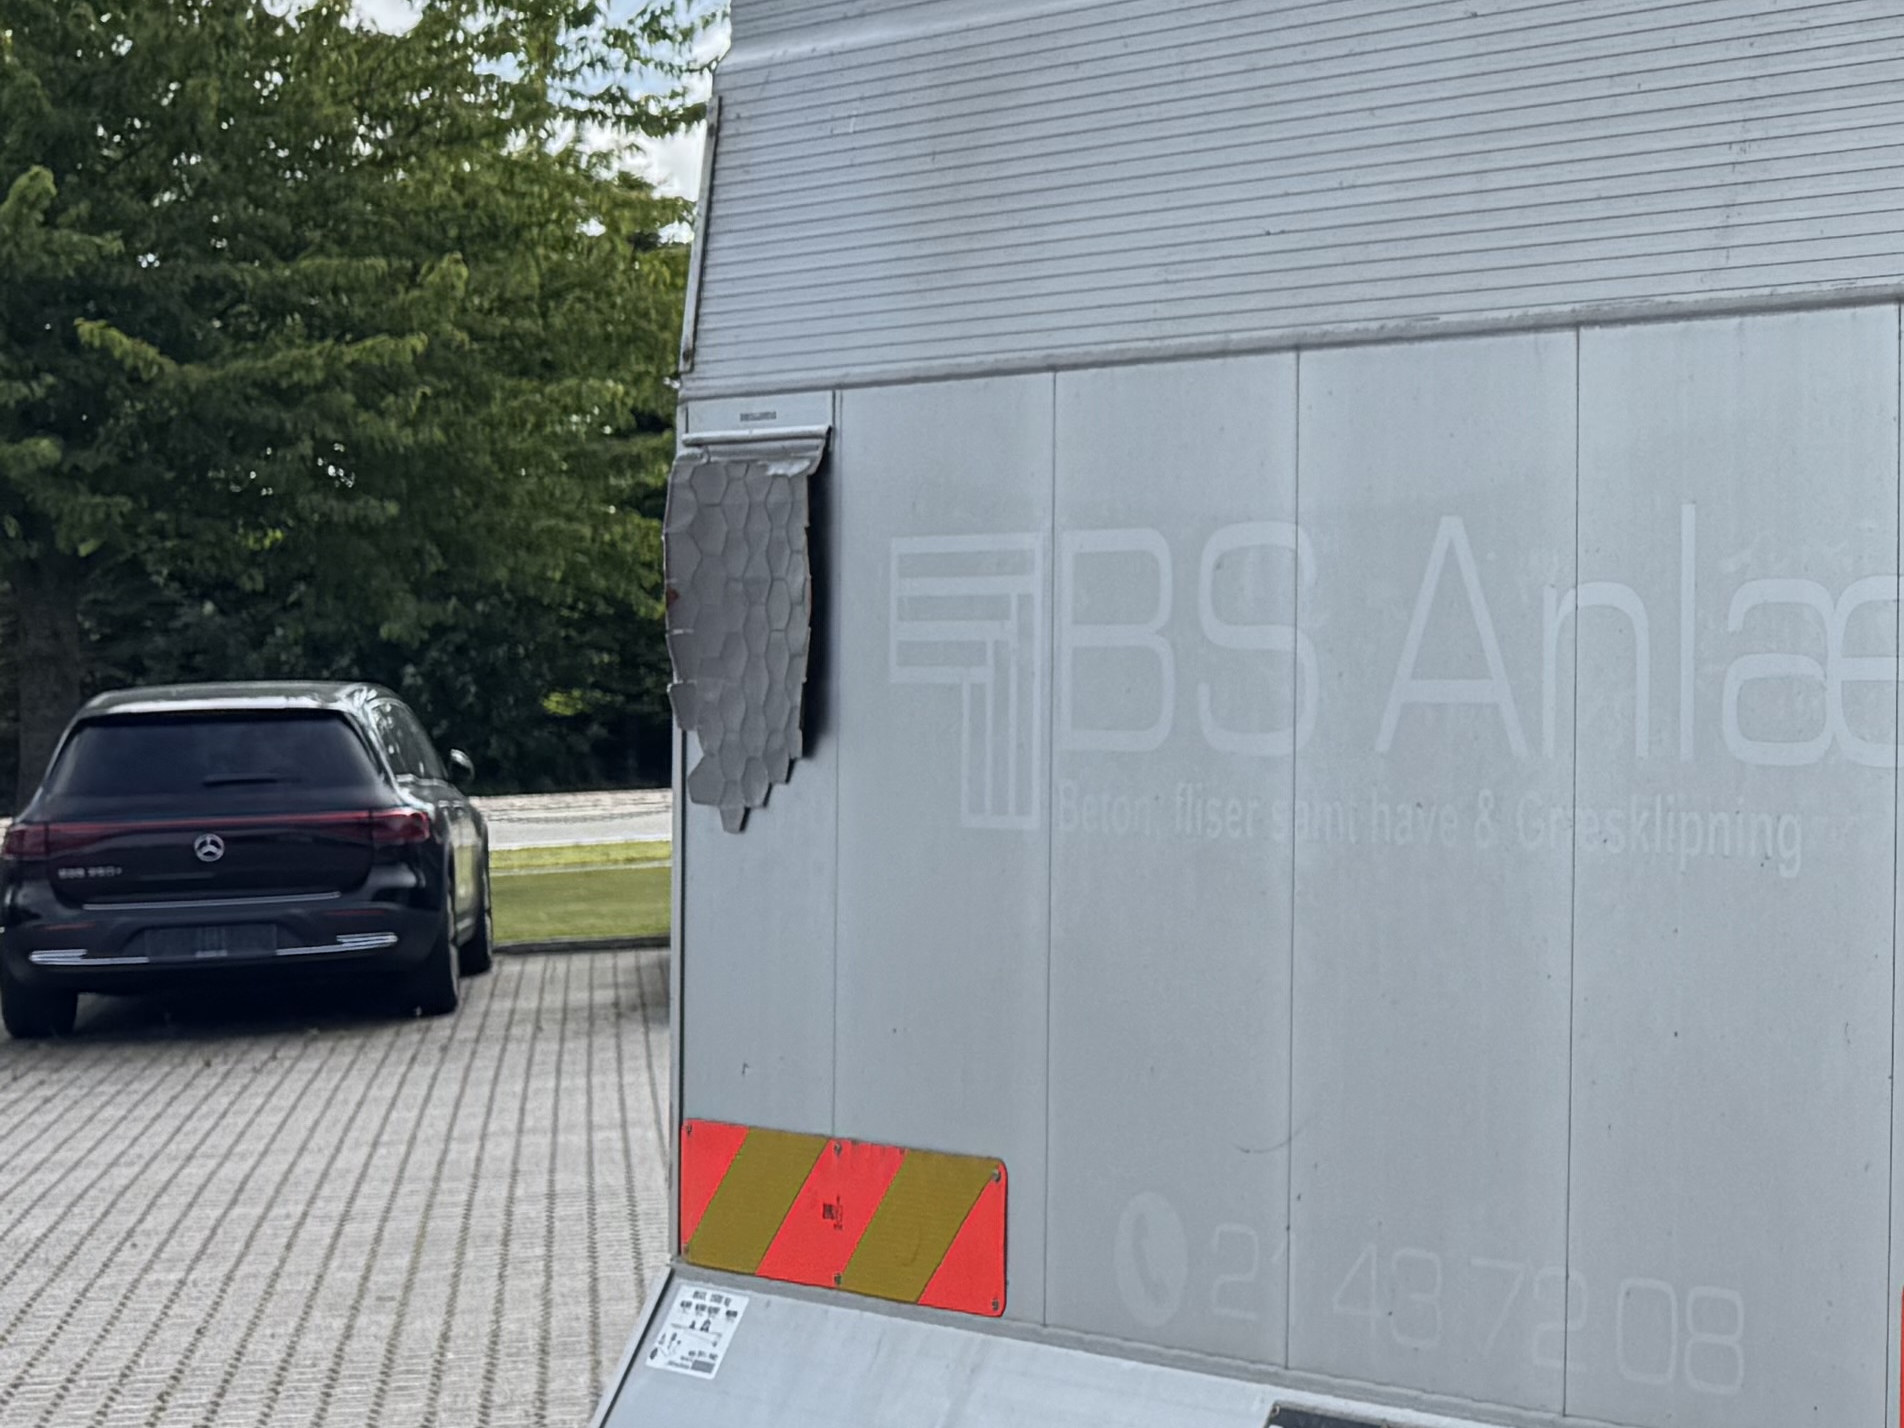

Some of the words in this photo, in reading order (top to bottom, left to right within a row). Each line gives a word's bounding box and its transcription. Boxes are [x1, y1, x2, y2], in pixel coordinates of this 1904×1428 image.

[1058, 521, 1318, 759] BS
[1371, 787, 1457, 848] have
[1474, 787, 1495, 849] &
[1331, 1242, 1443, 1349] 43
[1470, 1255, 1590, 1375] 72
[1615, 1275, 1746, 1396] 08
